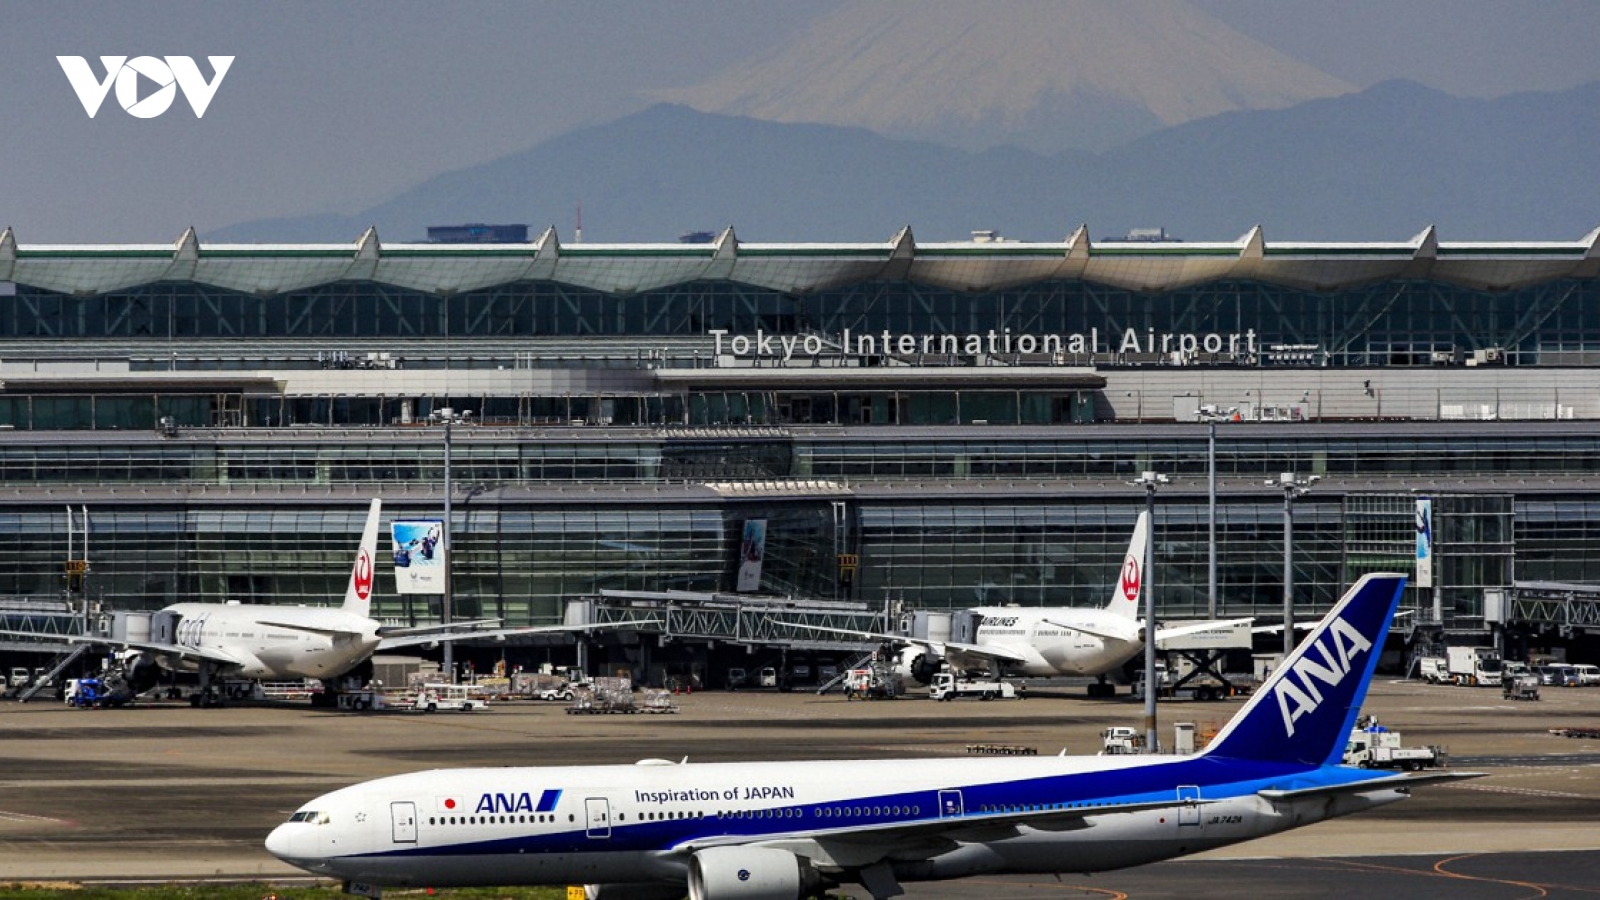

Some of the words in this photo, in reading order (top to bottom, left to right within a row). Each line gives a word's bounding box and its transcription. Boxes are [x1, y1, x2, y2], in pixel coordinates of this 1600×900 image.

[708, 329, 821, 361] Tokyo
[844, 328, 1097, 354] International
[1120, 328, 1257, 361] Airport
[1274, 616, 1372, 738] ANA
[475, 793, 533, 813] ANA
[635, 789, 719, 804] Inspiration
[724, 787, 739, 800] of
[744, 786, 794, 800] JAPAN
